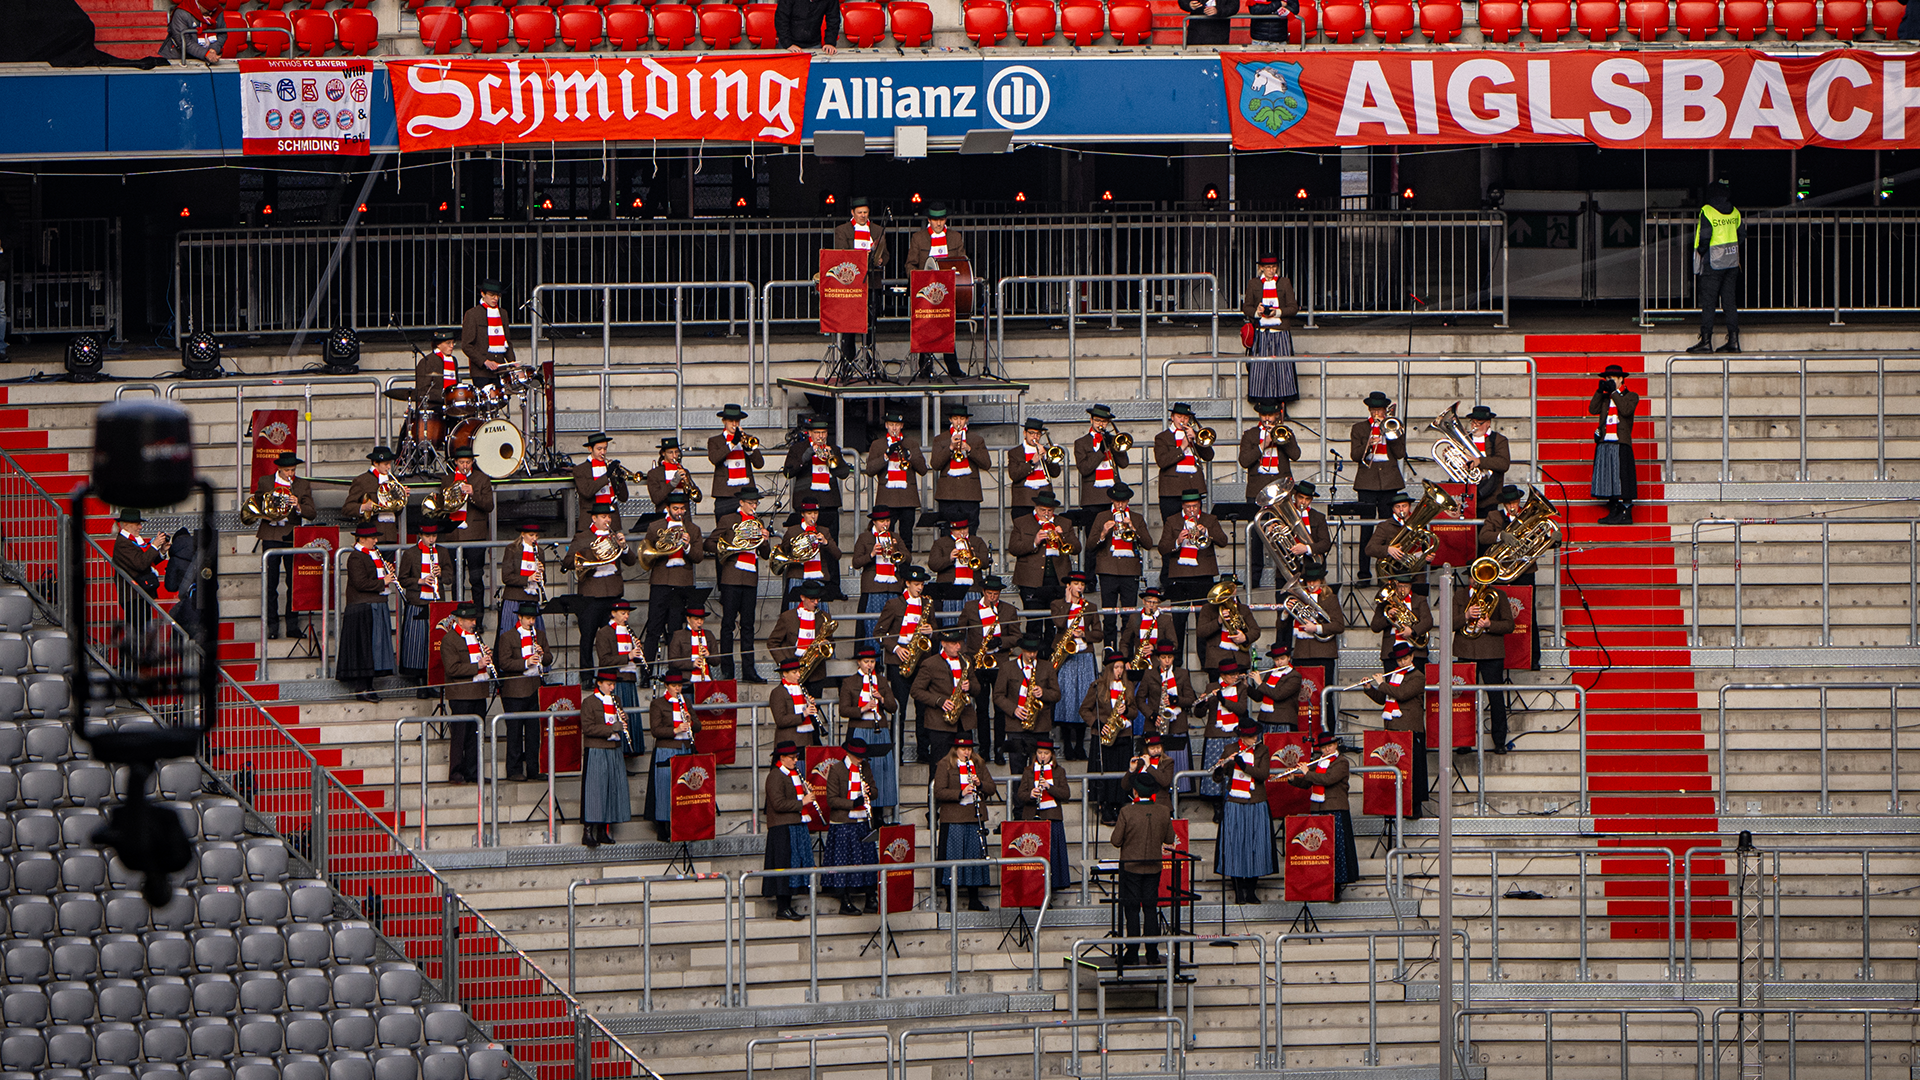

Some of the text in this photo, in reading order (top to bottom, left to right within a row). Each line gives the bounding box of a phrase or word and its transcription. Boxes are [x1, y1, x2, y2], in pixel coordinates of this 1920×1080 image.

[268, 60, 300, 68] MYTHOS
[342, 65, 366, 79] Willi
[407, 55, 799, 139] Schmiding
[815, 76, 977, 120] Allianz
[357, 108, 367, 120] &
[344, 132, 366, 144] Fati
[277, 140, 339, 151] SCHMIDING
